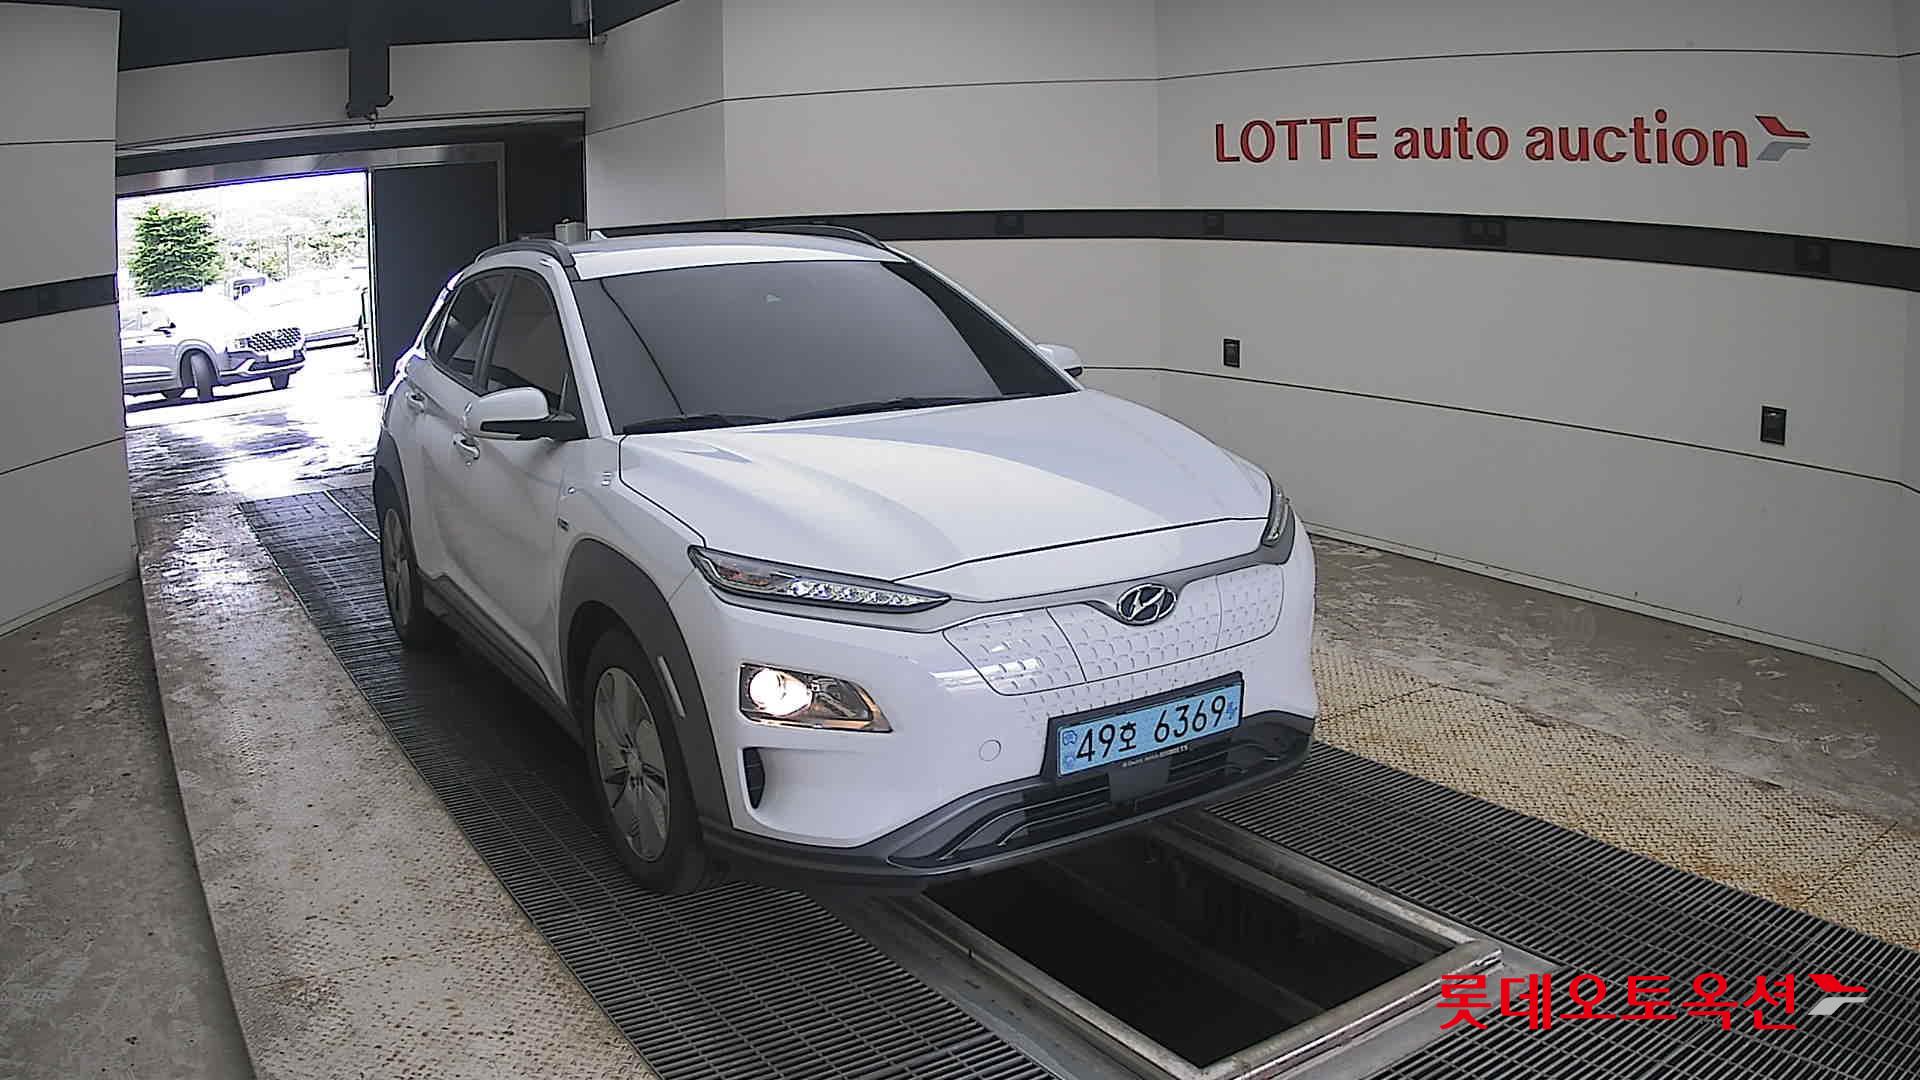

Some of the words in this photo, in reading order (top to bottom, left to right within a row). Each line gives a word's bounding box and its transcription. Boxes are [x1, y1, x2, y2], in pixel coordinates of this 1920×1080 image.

[1216, 116, 1378, 163] LOTTE
[1394, 117, 1509, 160] auto
[1525, 109, 1748, 168] auction
[1077, 721, 1137, 762] 49호
[1154, 695, 1226, 743] 6369
